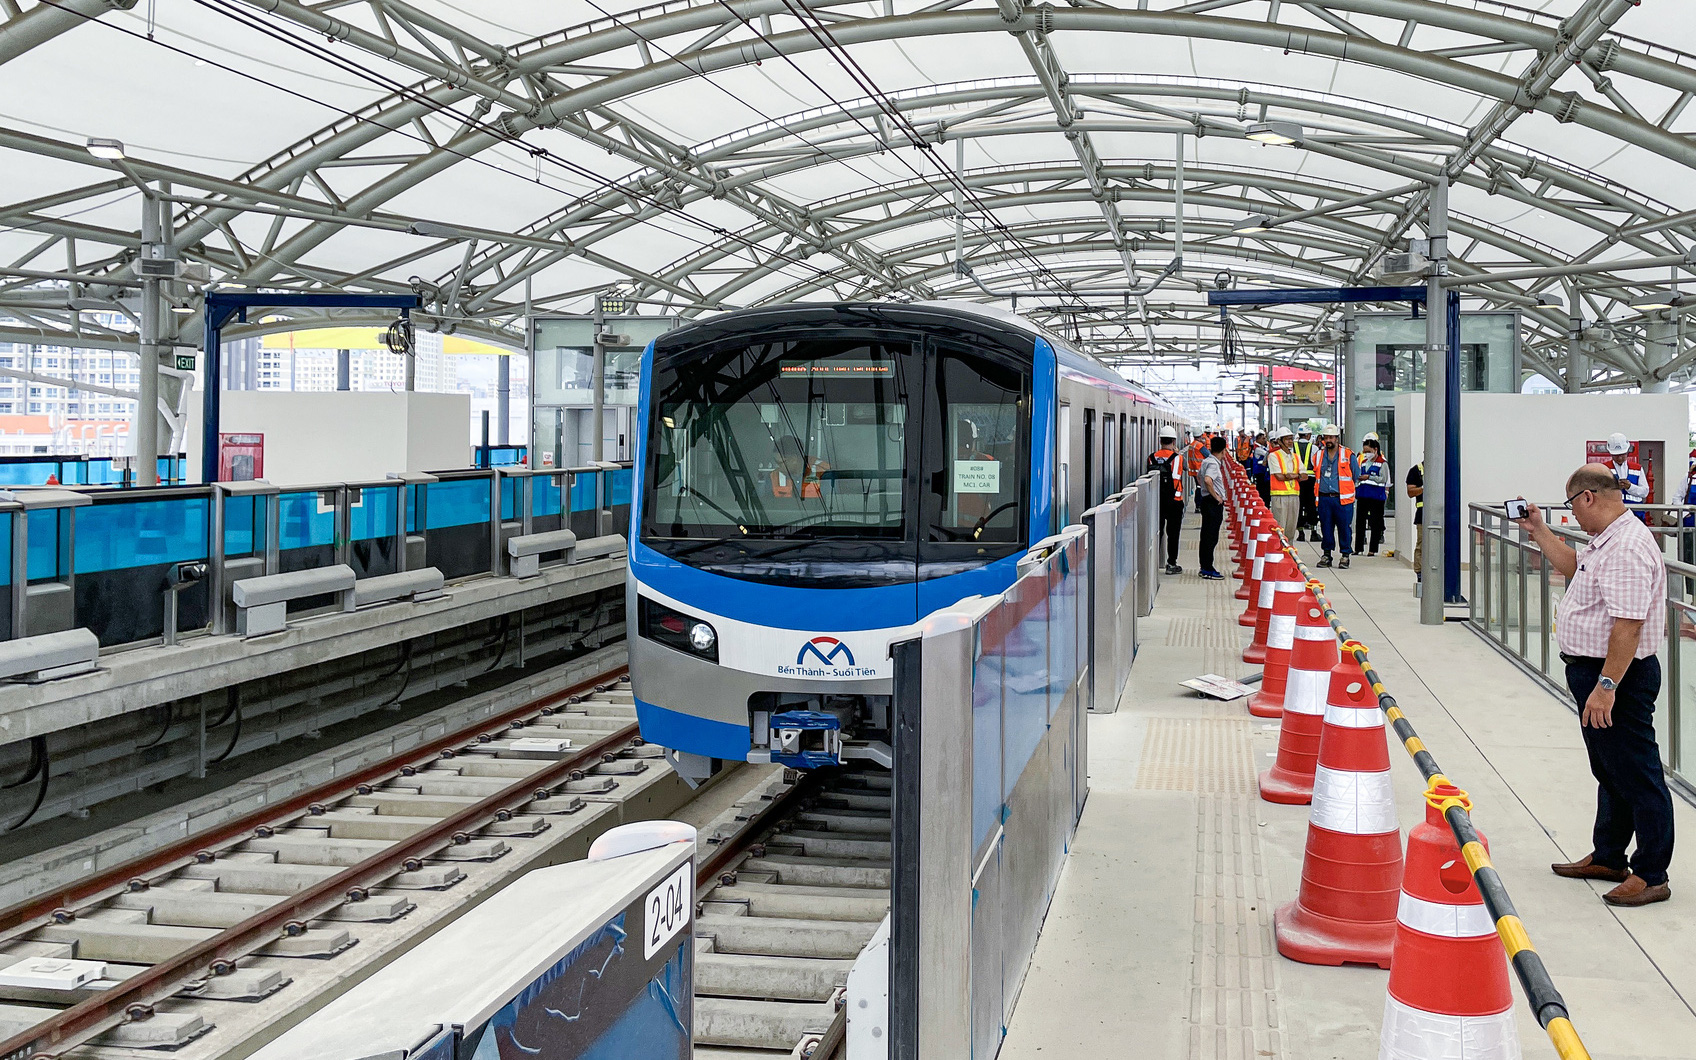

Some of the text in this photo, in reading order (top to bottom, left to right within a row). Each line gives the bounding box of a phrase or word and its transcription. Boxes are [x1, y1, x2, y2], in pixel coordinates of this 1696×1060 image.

[180, 357, 195, 369] EXIT
[777, 665, 795, 675] Bến
[796, 667, 825, 677] Thành
[833, 667, 854, 677] Suối
[855, 667, 876, 676] Tiên
[652, 875, 683, 947] 2-04
